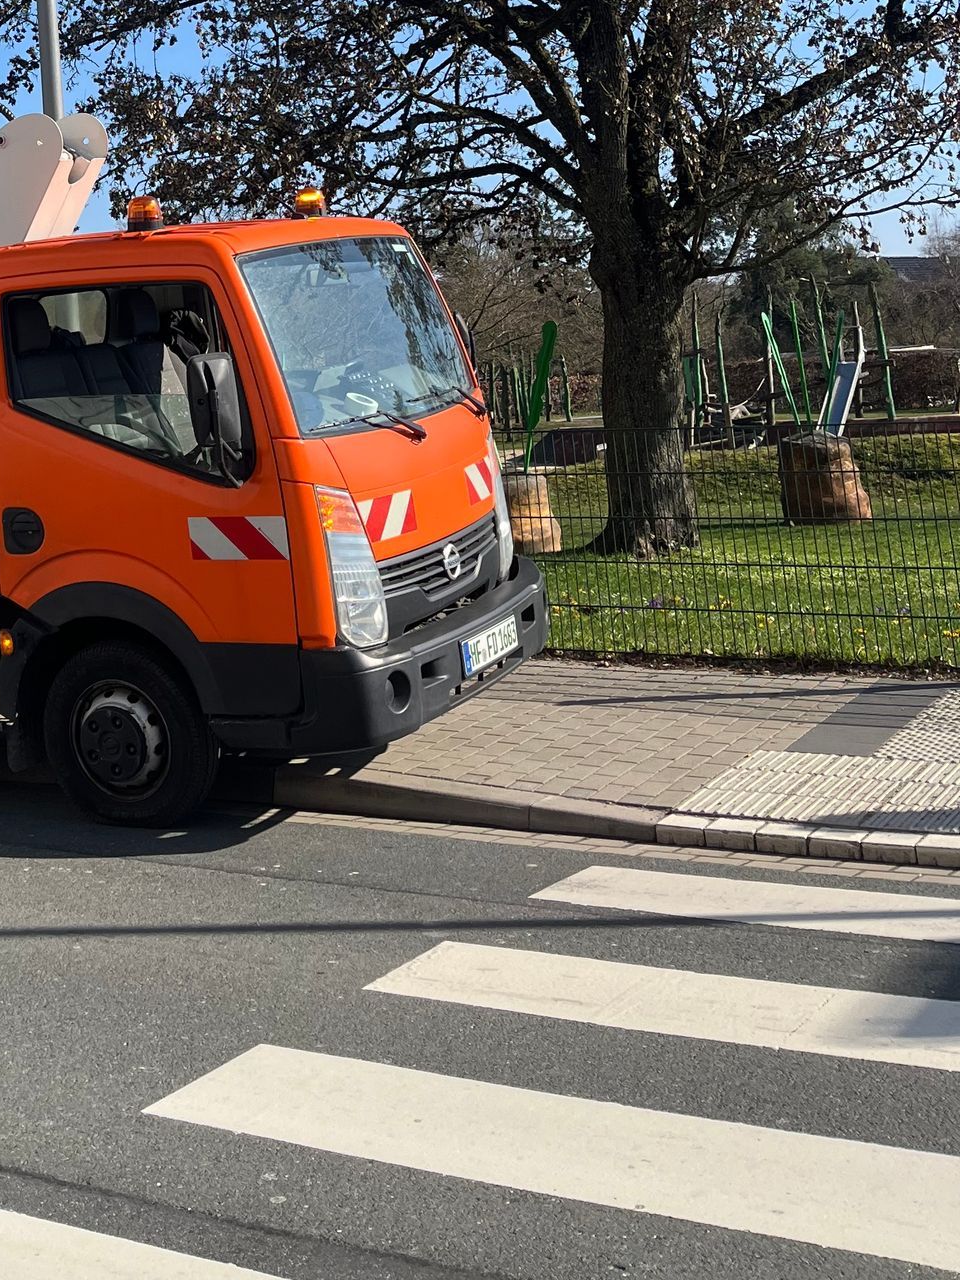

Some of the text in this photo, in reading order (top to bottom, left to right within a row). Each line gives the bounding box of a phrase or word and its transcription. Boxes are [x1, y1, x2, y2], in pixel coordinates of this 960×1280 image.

[470, 621, 517, 667] HF FD 1683
